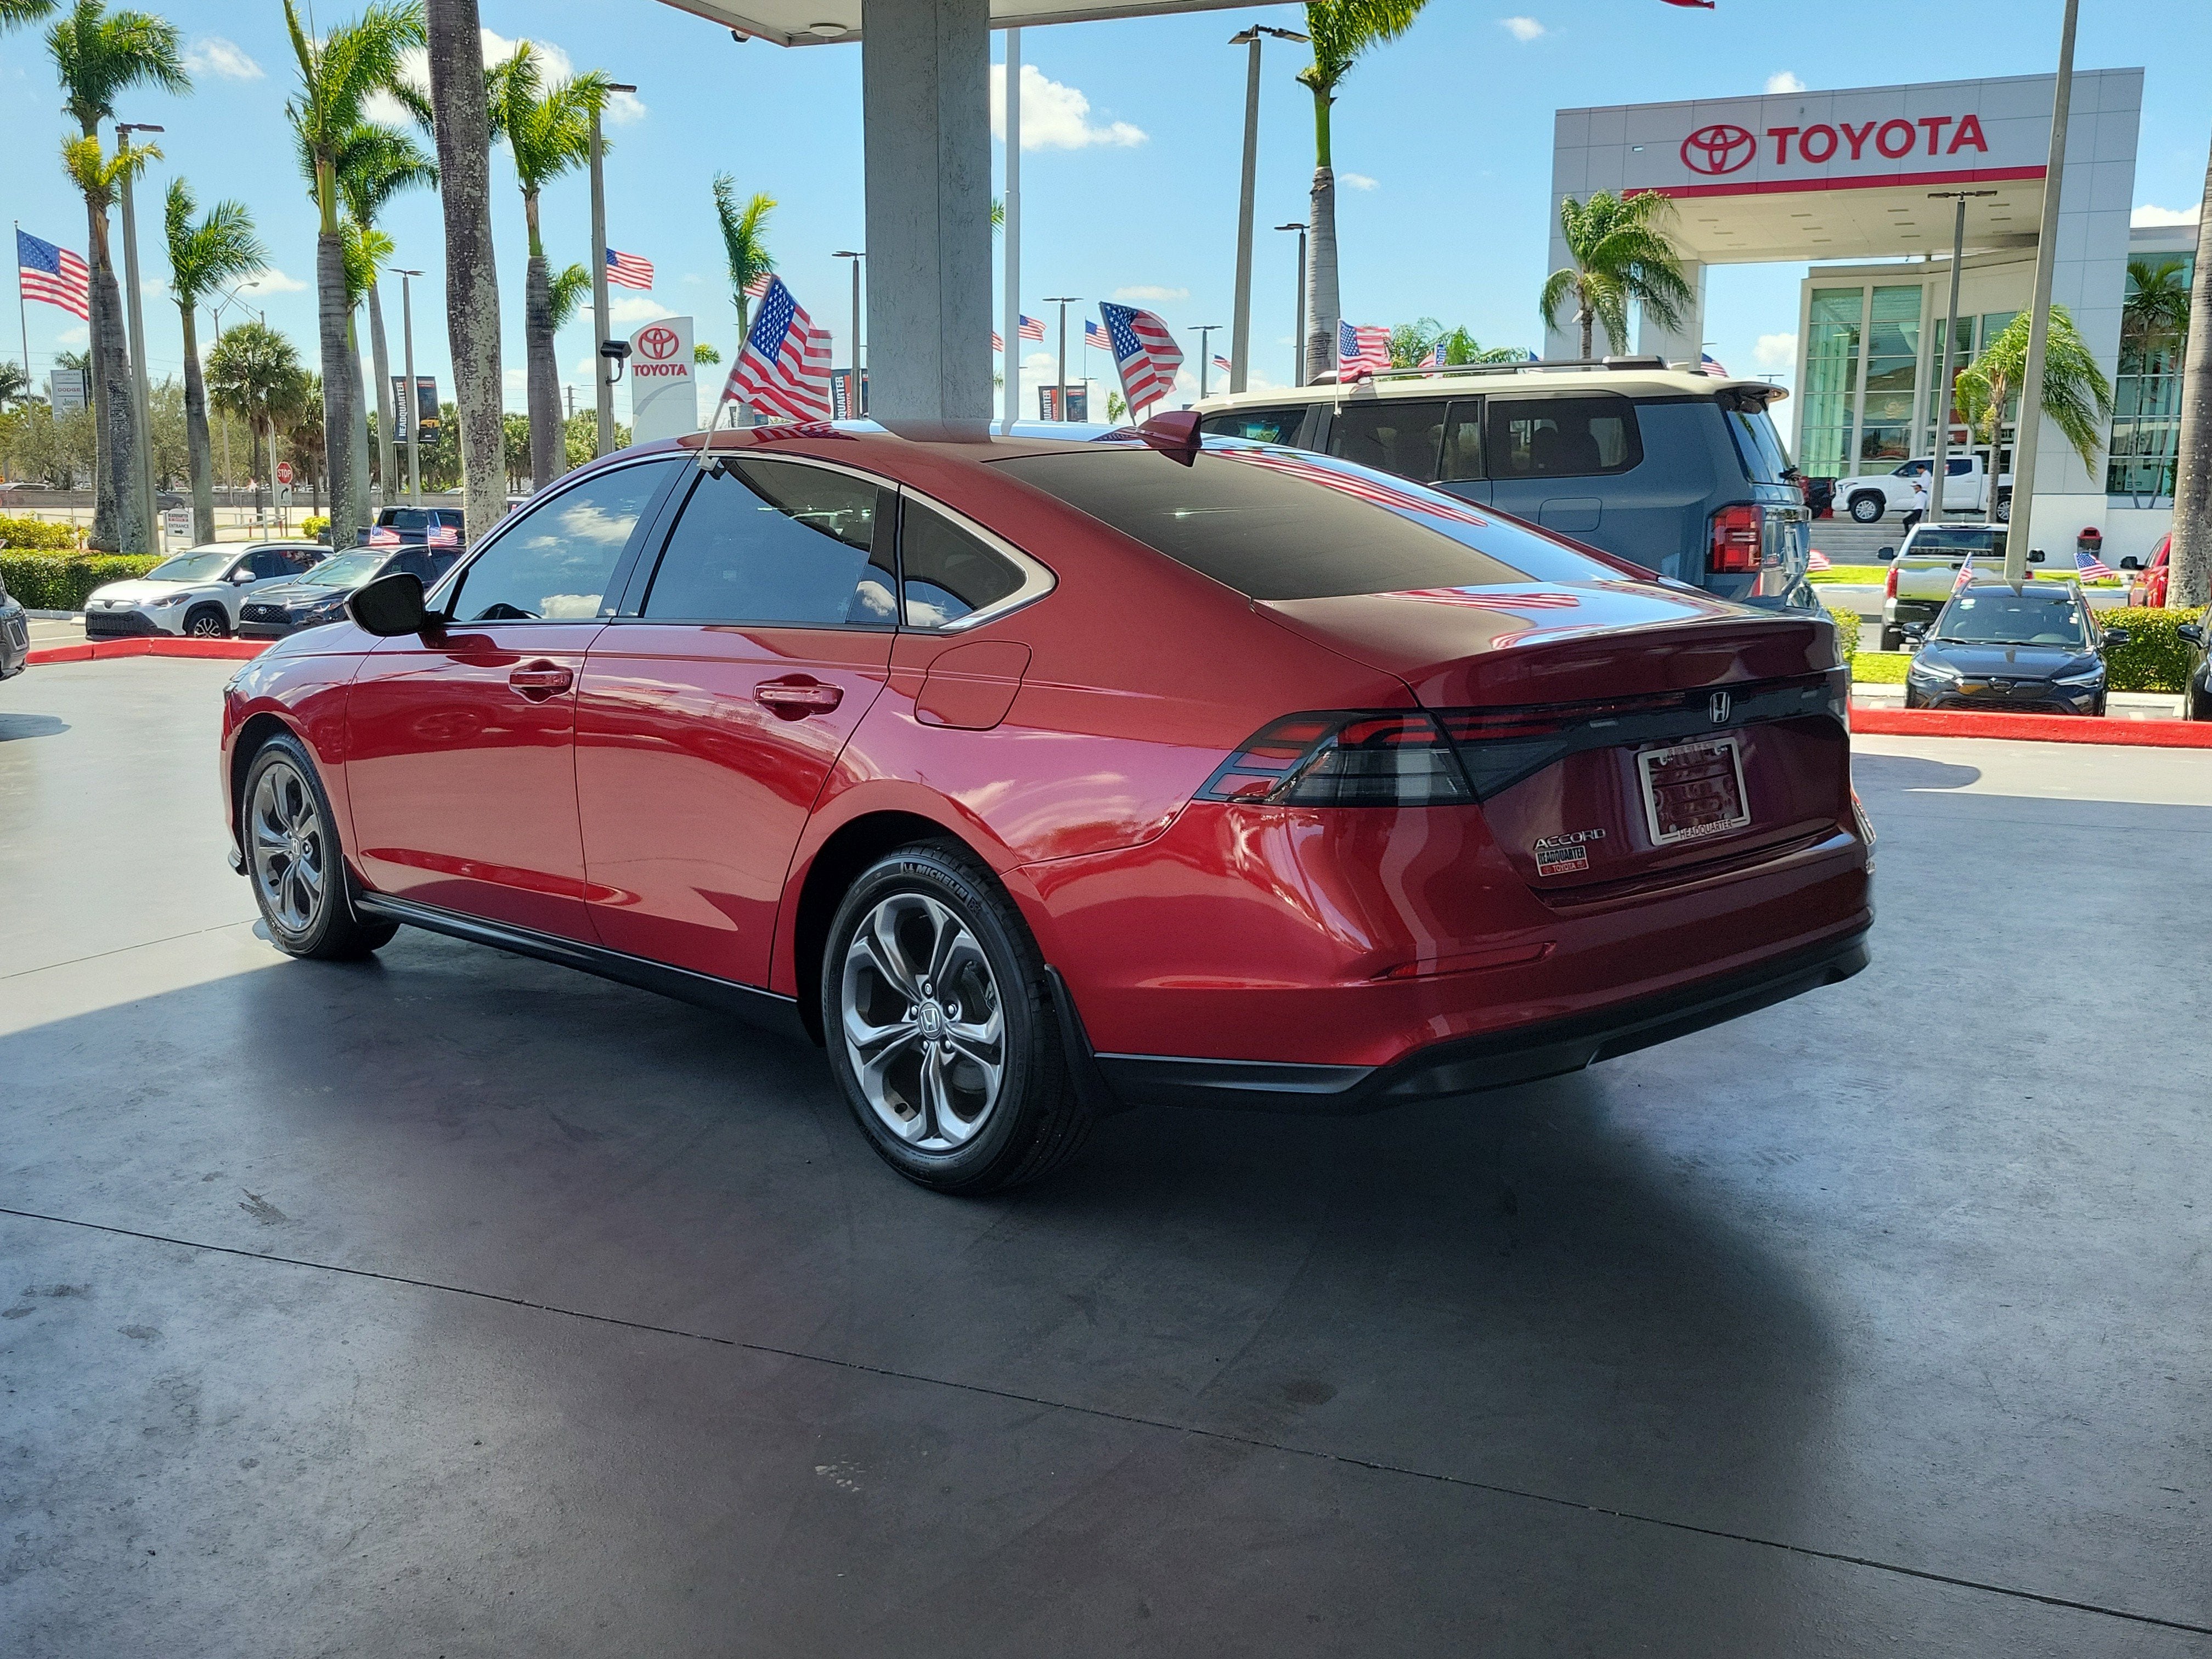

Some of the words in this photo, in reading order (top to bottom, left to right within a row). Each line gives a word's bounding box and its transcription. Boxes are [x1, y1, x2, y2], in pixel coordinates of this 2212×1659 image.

[1767, 114, 1988, 165] TOYOTA
[633, 364, 687, 376] TOYOTA
[396, 381, 408, 437] HEADQUARTER
[278, 469, 291, 478] STOP
[1534, 828, 1606, 850] ACCORD
[1680, 820, 1733, 839] HEADQUARTER
[1538, 847, 1585, 866] HEADQUARTER
[1553, 862, 1577, 872] TOYOTA
[916, 865, 968, 899] MICHELIN
